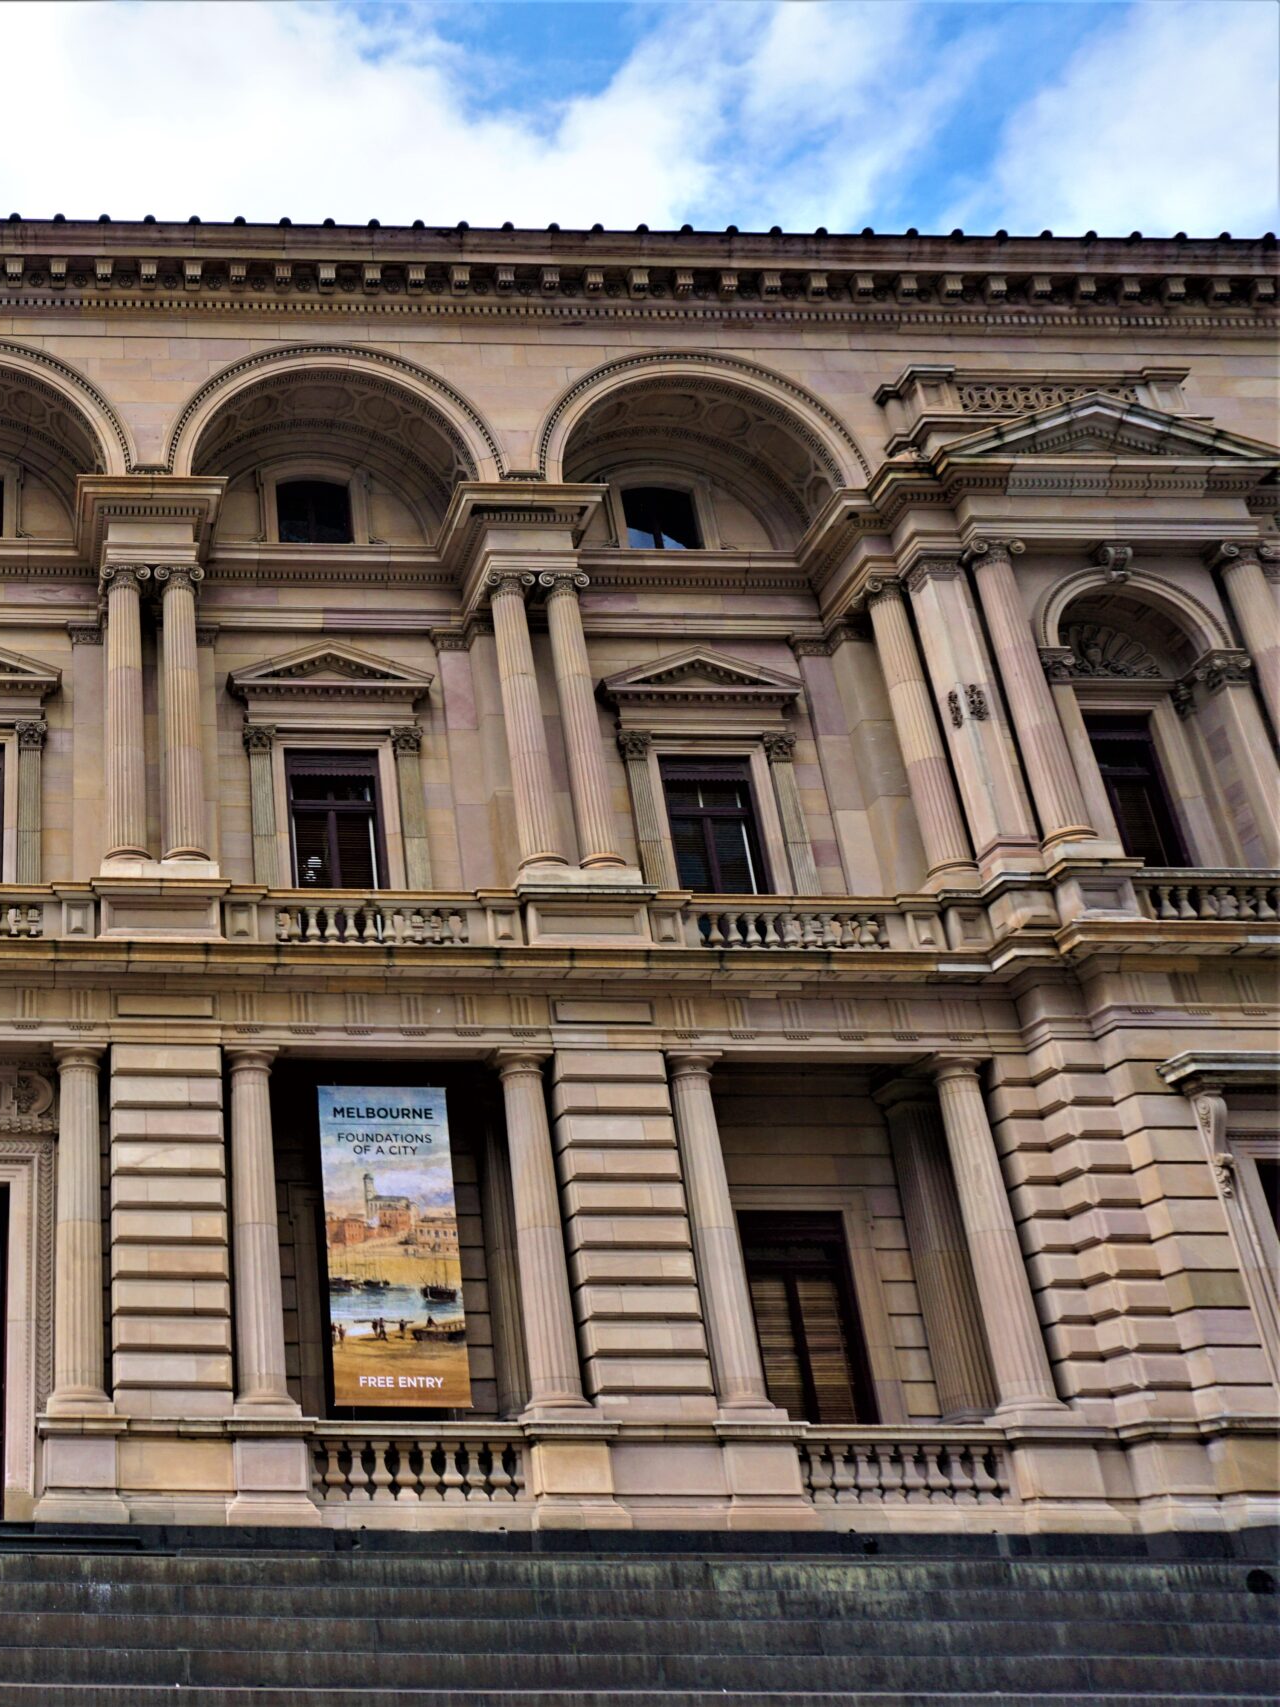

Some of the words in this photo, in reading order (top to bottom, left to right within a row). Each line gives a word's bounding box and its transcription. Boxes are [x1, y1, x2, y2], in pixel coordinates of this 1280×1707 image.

[332, 1106, 434, 1120] MELBOURNE
[337, 1132, 433, 1144] FOUNDATIONS
[353, 1144, 371, 1155] OF
[375, 1145, 385, 1155] A
[388, 1145, 419, 1156] CITY
[359, 1375, 395, 1388] FREE
[398, 1376, 445, 1389] ENTRY
